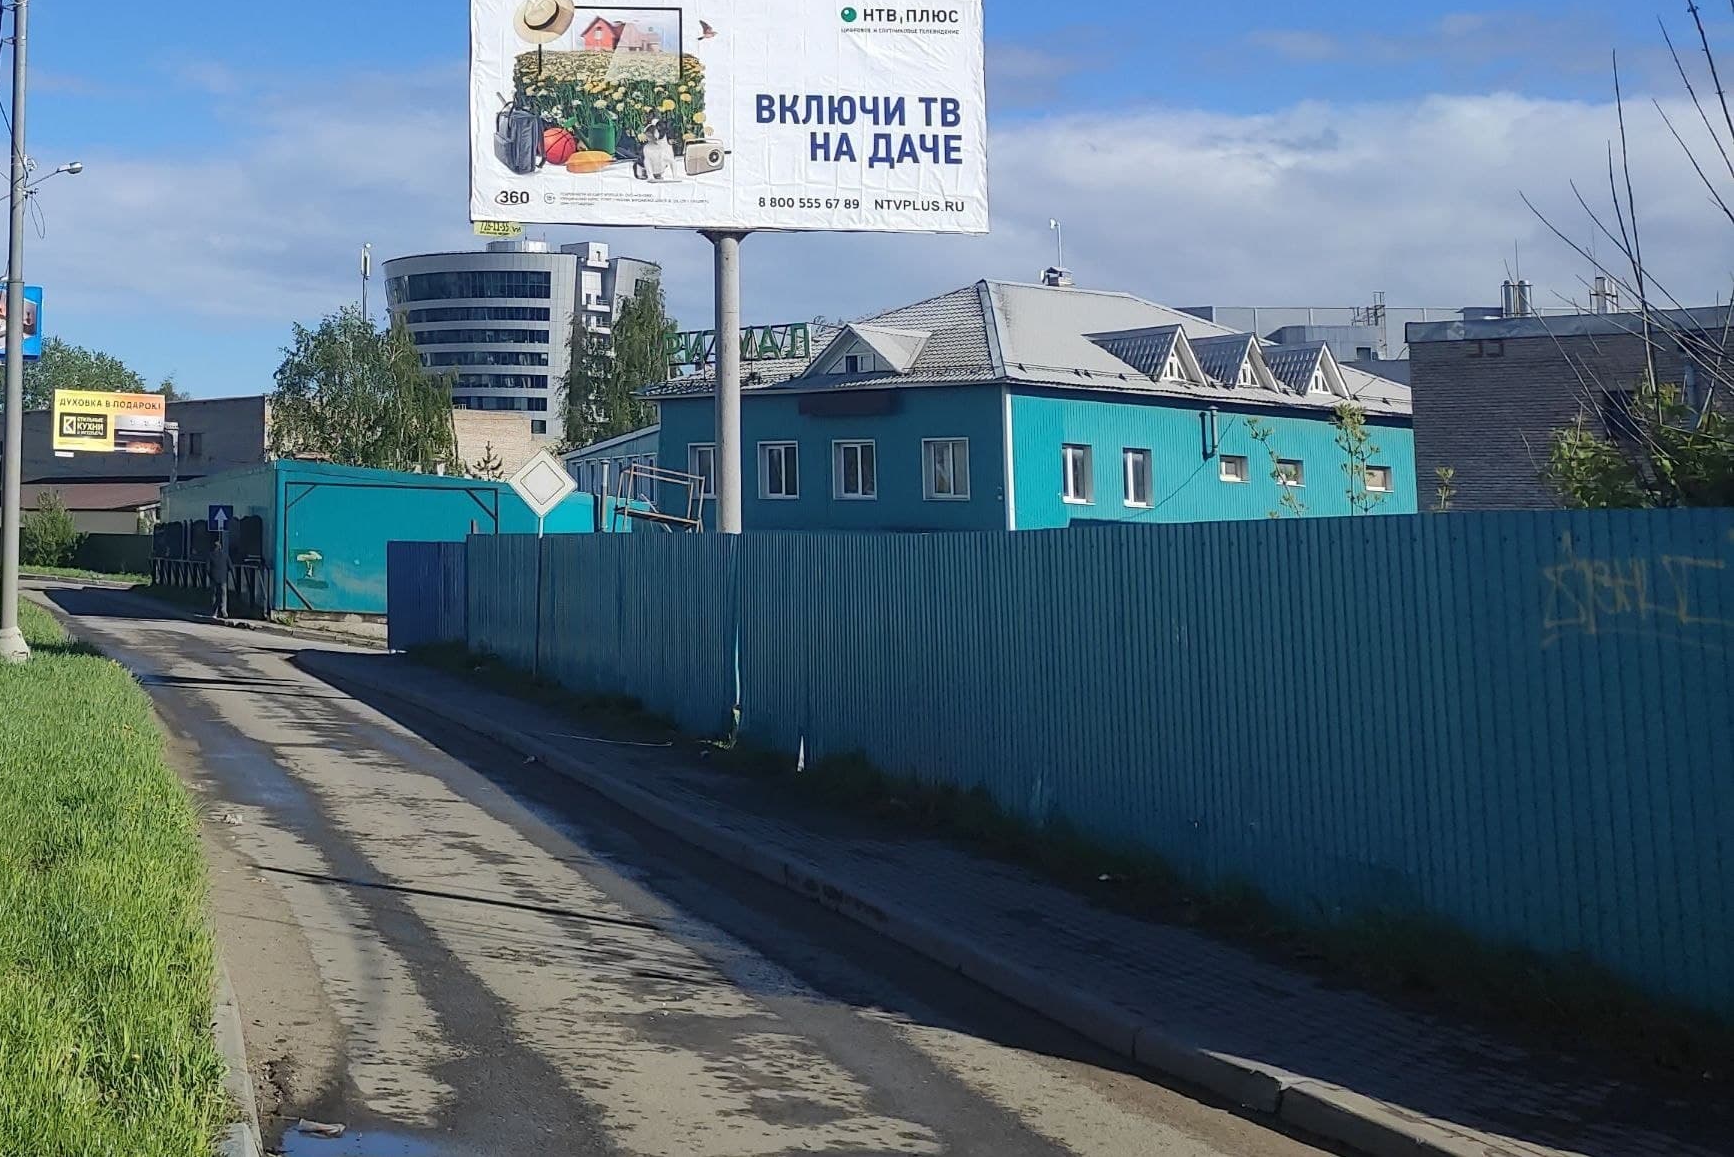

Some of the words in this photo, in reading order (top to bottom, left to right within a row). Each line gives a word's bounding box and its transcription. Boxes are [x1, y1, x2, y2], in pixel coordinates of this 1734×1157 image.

[756, 94, 906, 127] ВКЛЮЧИ
[918, 97, 961, 128] ТВ
[810, 132, 857, 163] НА
[868, 133, 963, 169] ДАЧЕ
[499, 190, 530, 204] 360
[758, 197, 766, 207] 8
[770, 197, 795, 208] 800
[799, 198, 821, 209] 555
[825, 198, 840, 209] 67
[844, 199, 860, 210] 89
[874, 199, 965, 212] NTVPLUS.RU
[663, 322, 811, 364] РИУАЛ
[59, 398, 103, 407] ДУХОВКА
[105, 399, 111, 408] В
[76, 422, 104, 431] КУХНИ
